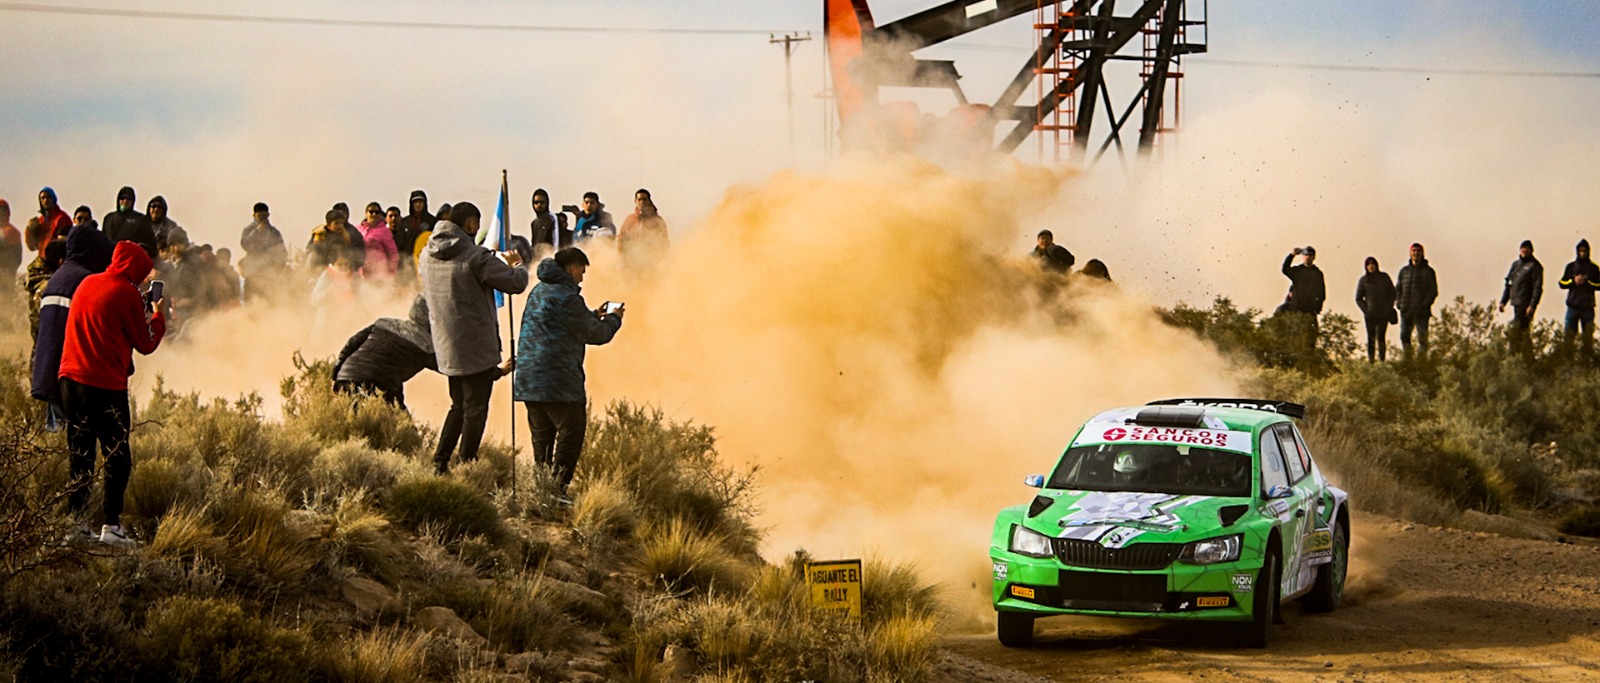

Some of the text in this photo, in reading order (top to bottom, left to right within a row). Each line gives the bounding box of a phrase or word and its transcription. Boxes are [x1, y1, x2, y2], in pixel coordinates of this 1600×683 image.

[1130, 433, 1228, 447] SEGUROS
[1132, 427, 1228, 441] SANCOR
[812, 568, 859, 584] AGUANTE EL
[1232, 576, 1252, 585] NON
[824, 588, 848, 603] RALLY
[1198, 597, 1228, 606] PIRELLI
